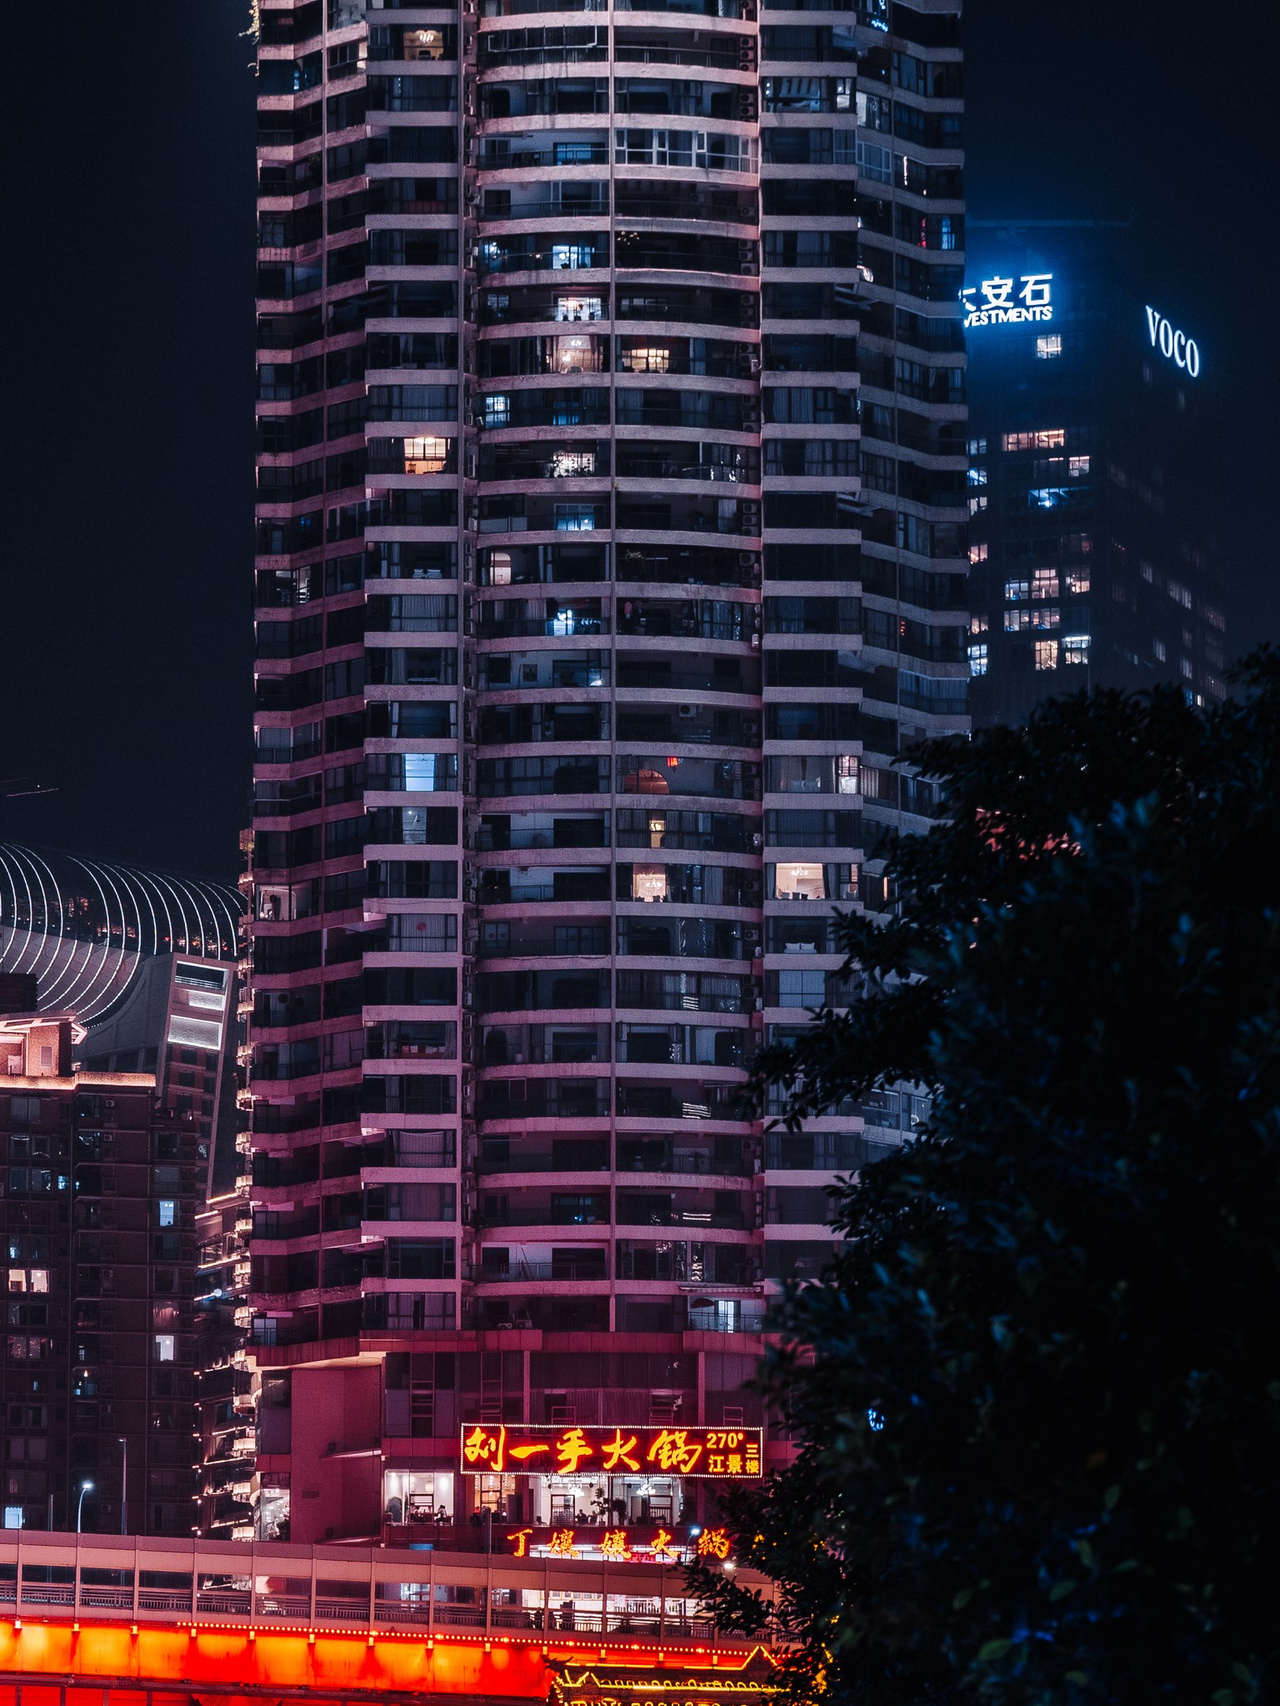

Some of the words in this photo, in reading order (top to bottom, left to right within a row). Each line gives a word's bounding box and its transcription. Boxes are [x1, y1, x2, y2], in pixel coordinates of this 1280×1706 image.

[1145, 304, 1200, 378] VOCO
[464, 1425, 703, 1473] 刘一手火锅
[708, 1454, 743, 1474] 江景
